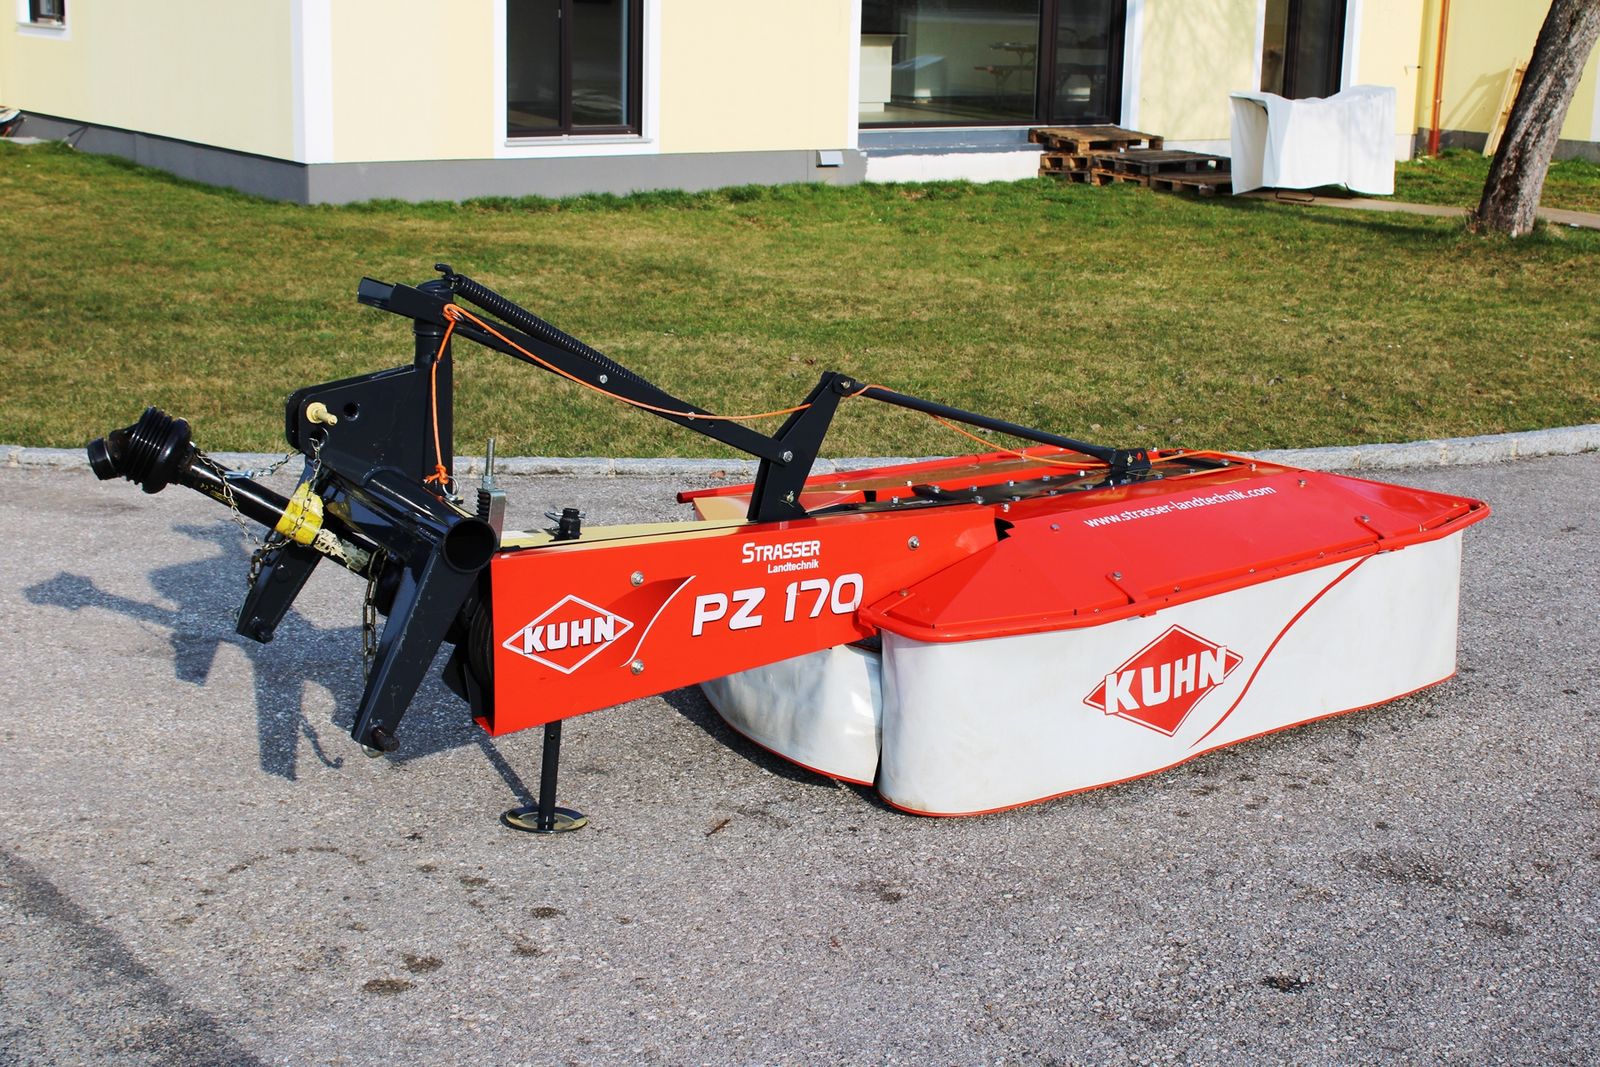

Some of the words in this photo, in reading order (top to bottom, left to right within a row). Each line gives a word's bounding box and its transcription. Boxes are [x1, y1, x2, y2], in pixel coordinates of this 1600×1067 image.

[1084, 486, 1277, 528] www.strasser-landtechnik.com
[742, 540, 821, 564] STRASSER
[767, 560, 820, 574] Landtechnik
[692, 587, 766, 637] PZ
[784, 573, 863, 622] 170
[523, 615, 616, 654] KUHN
[1105, 645, 1227, 714] KUHN
